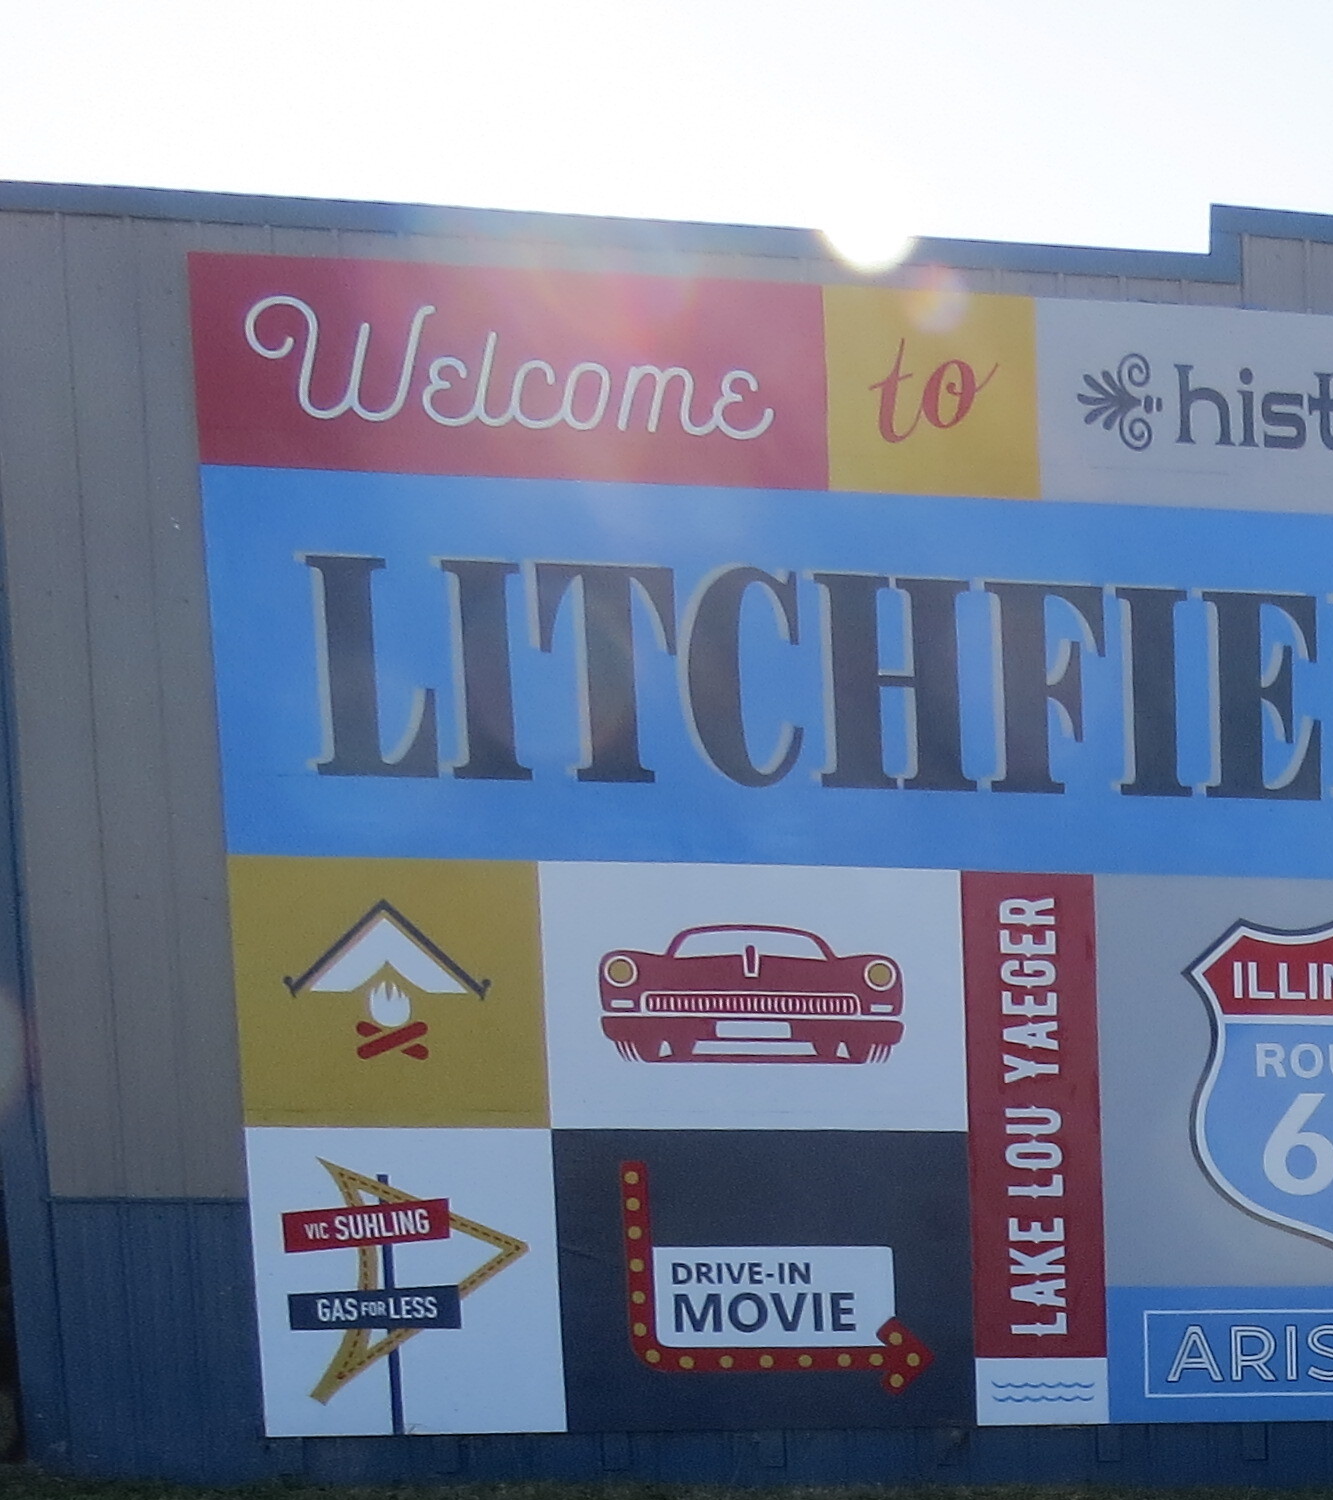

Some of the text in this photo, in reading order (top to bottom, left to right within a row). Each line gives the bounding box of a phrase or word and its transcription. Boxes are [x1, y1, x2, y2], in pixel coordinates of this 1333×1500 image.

[245, 295, 999, 444] Welcome to
[999, 896, 1069, 1338] LAKE LOU YAEGER
[304, 1208, 431, 1241] VIC SUHLING
[671, 1261, 812, 1286] DRIVE-IN
[316, 1296, 438, 1322] GAS FOR LESS
[673, 1291, 858, 1334] MOVIE
